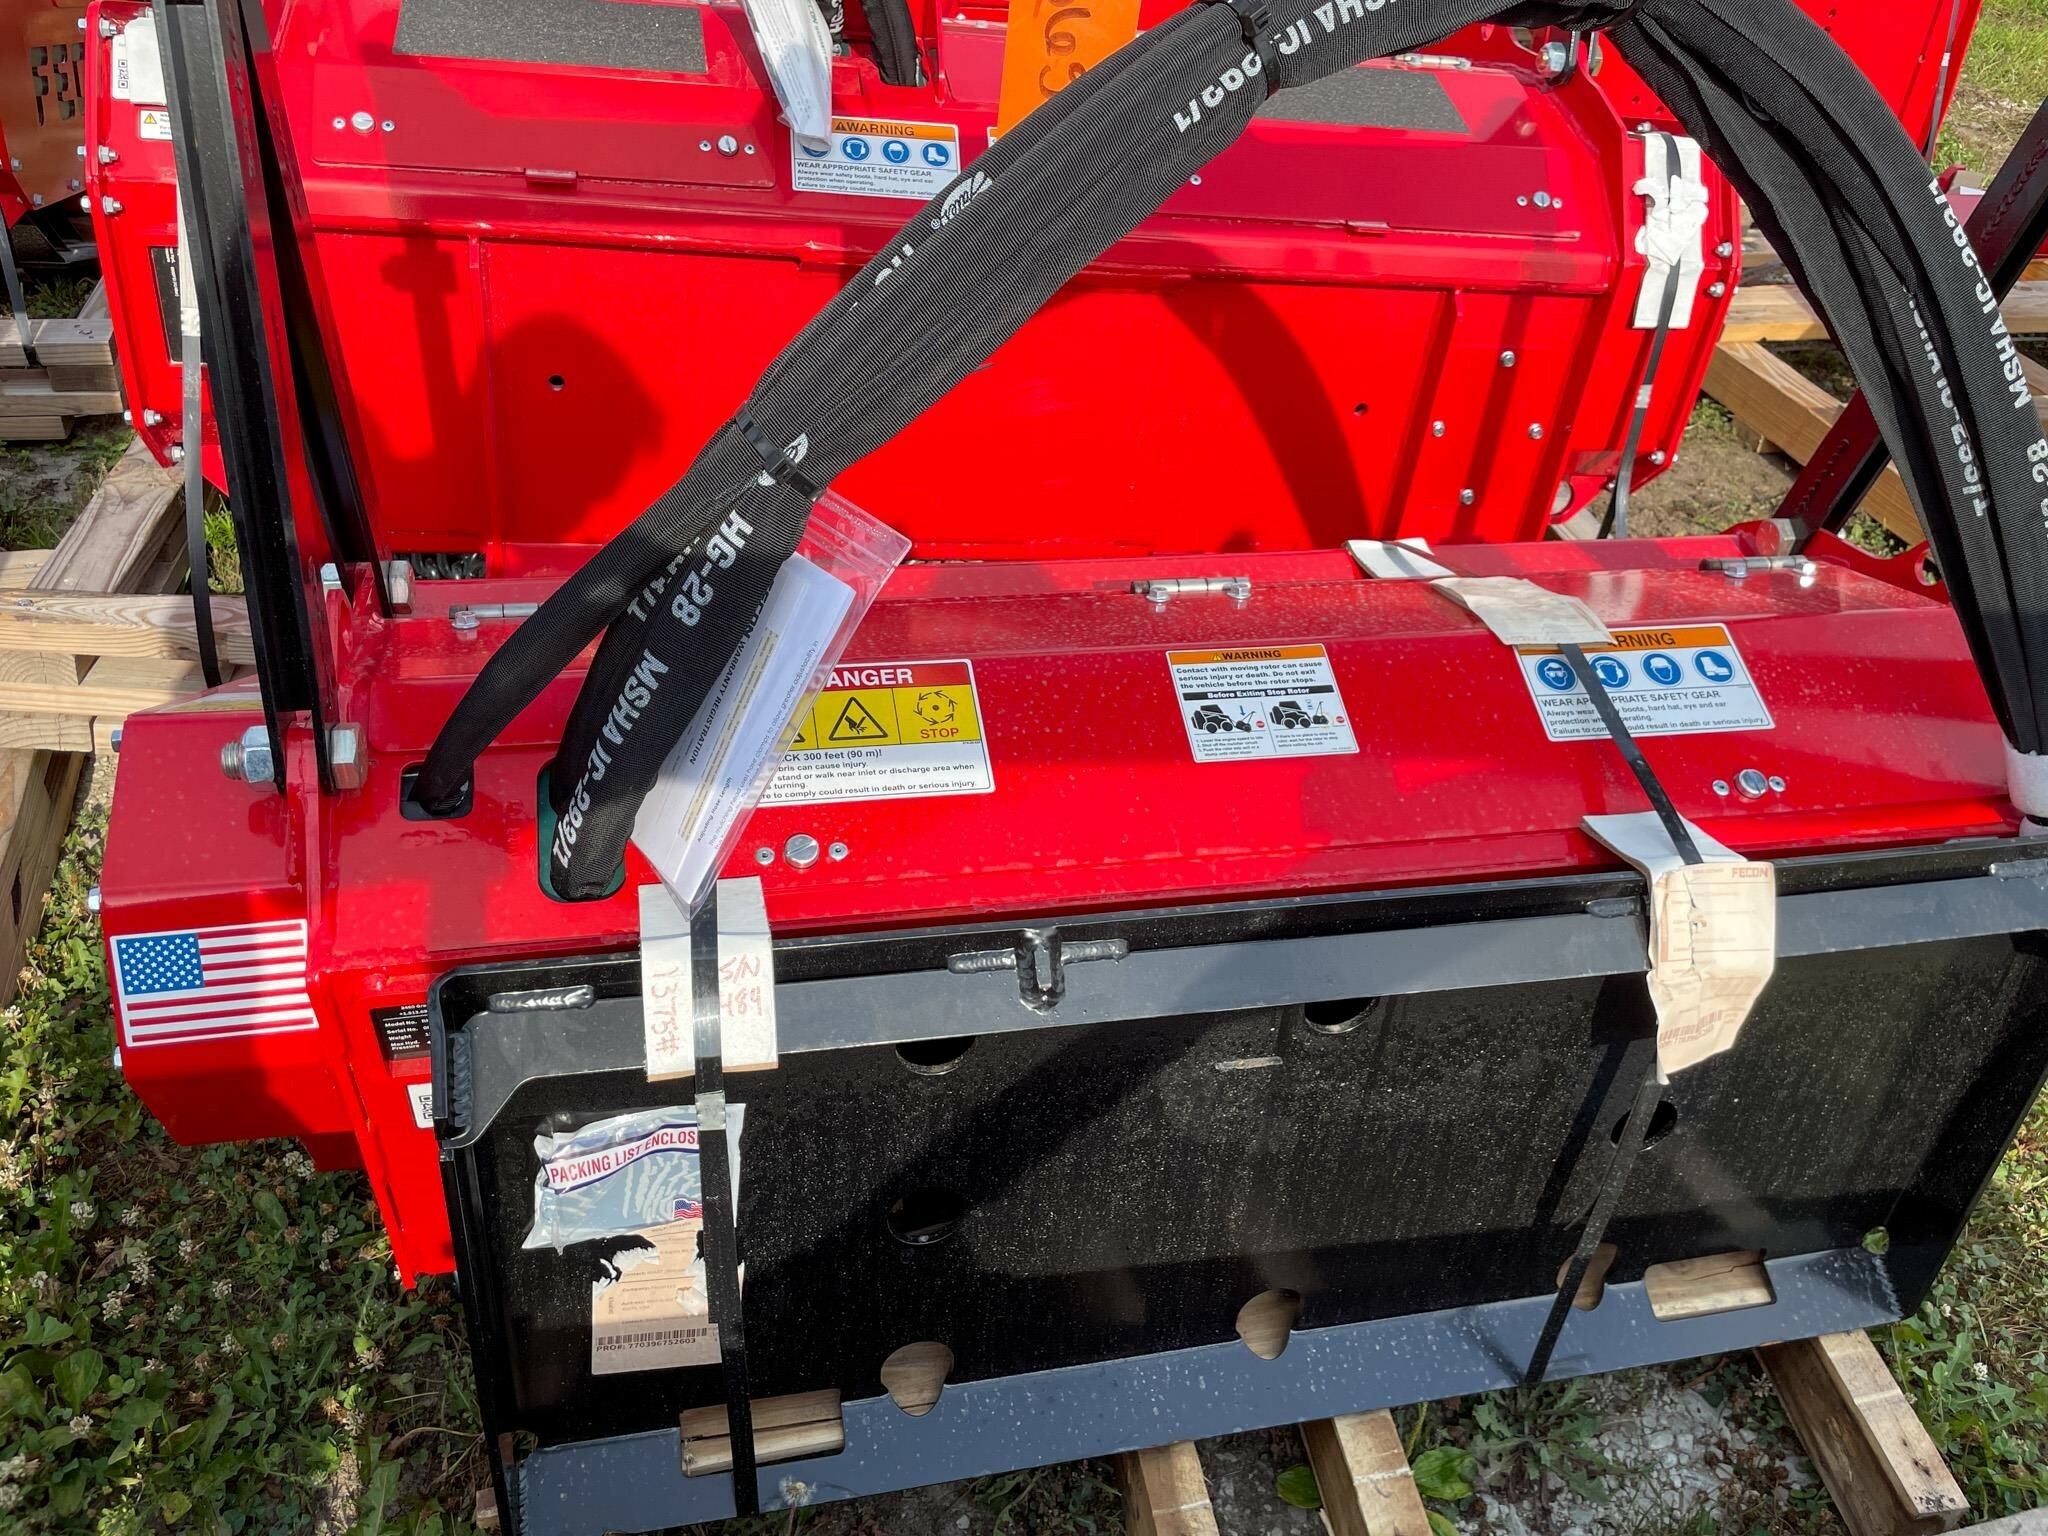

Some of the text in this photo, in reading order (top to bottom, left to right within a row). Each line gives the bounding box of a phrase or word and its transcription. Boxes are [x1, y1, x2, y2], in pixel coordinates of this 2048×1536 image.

[1173, 19, 1312, 133] IC293/1
[846, 122, 915, 136] WARNING
[797, 161, 932, 177] WEAR APPROPRIATE SAFETY GEAR
[1989, 312, 2033, 409] MSHA
[671, 509, 754, 628] HG-28
[1608, 632, 1676, 648] RNING
[1222, 650, 1281, 660] WARNING
[720, 640, 746, 697] WARRANTY
[1176, 666, 1209, 674] Contact
[1230, 665, 1259, 673] moving
[1178, 674, 1208, 682] serious
[1210, 673, 1233, 682] injury
[1291, 676, 1316, 684] stops.
[604, 649, 670, 744] MSHA
[1207, 687, 1310, 699] Before Exiting Stop Rotor
[1541, 689, 1721, 708] WEAR APPRIATE SAFETY GEAR
[1546, 709, 1575, 718] Always
[1622, 705, 1648, 714] boots,
[1650, 703, 1668, 711] hard
[755, 734, 770, 759] clamps
[772, 708, 782, 727] allow
[781, 684, 795, 710] greater
[1549, 716, 1588, 726] protection
[1620, 714, 1653, 723] perating.
[1553, 726, 1581, 735] Failure
[1627, 723, 1645, 731] ould
[1646, 721, 1667, 730] result
[1669, 720, 1677, 728] in
[1678, 719, 1700, 728] death
[1712, 718, 1740, 726] serious
[689, 698, 722, 765] REGISTRATION
[920, 728, 959, 739] STOP
[783, 749, 883, 762] CK 300 feet (90 m)!
[777, 773, 802, 781] stand
[815, 770, 835, 779] walk
[858, 768, 876, 776] inlet
[889, 766, 930, 776] discharge
[778, 764, 795, 772] bris
[815, 762, 840, 770] cause
[842, 760, 868, 770] injury.
[774, 781, 808, 791] turning.
[784, 789, 816, 800] comply
[819, 788, 843, 796] could
[845, 786, 870, 794] result
[881, 783, 905, 791] death
[951, 780, 977, 788] injury.
[552, 743, 613, 869] IC-293/1
[1731, 866, 1769, 879] FECON
[719, 953, 761, 984] S/N
[550, 1130, 699, 1184] PACKING LIST ENCLOS
[596, 1344, 626, 1352] PRO#:
